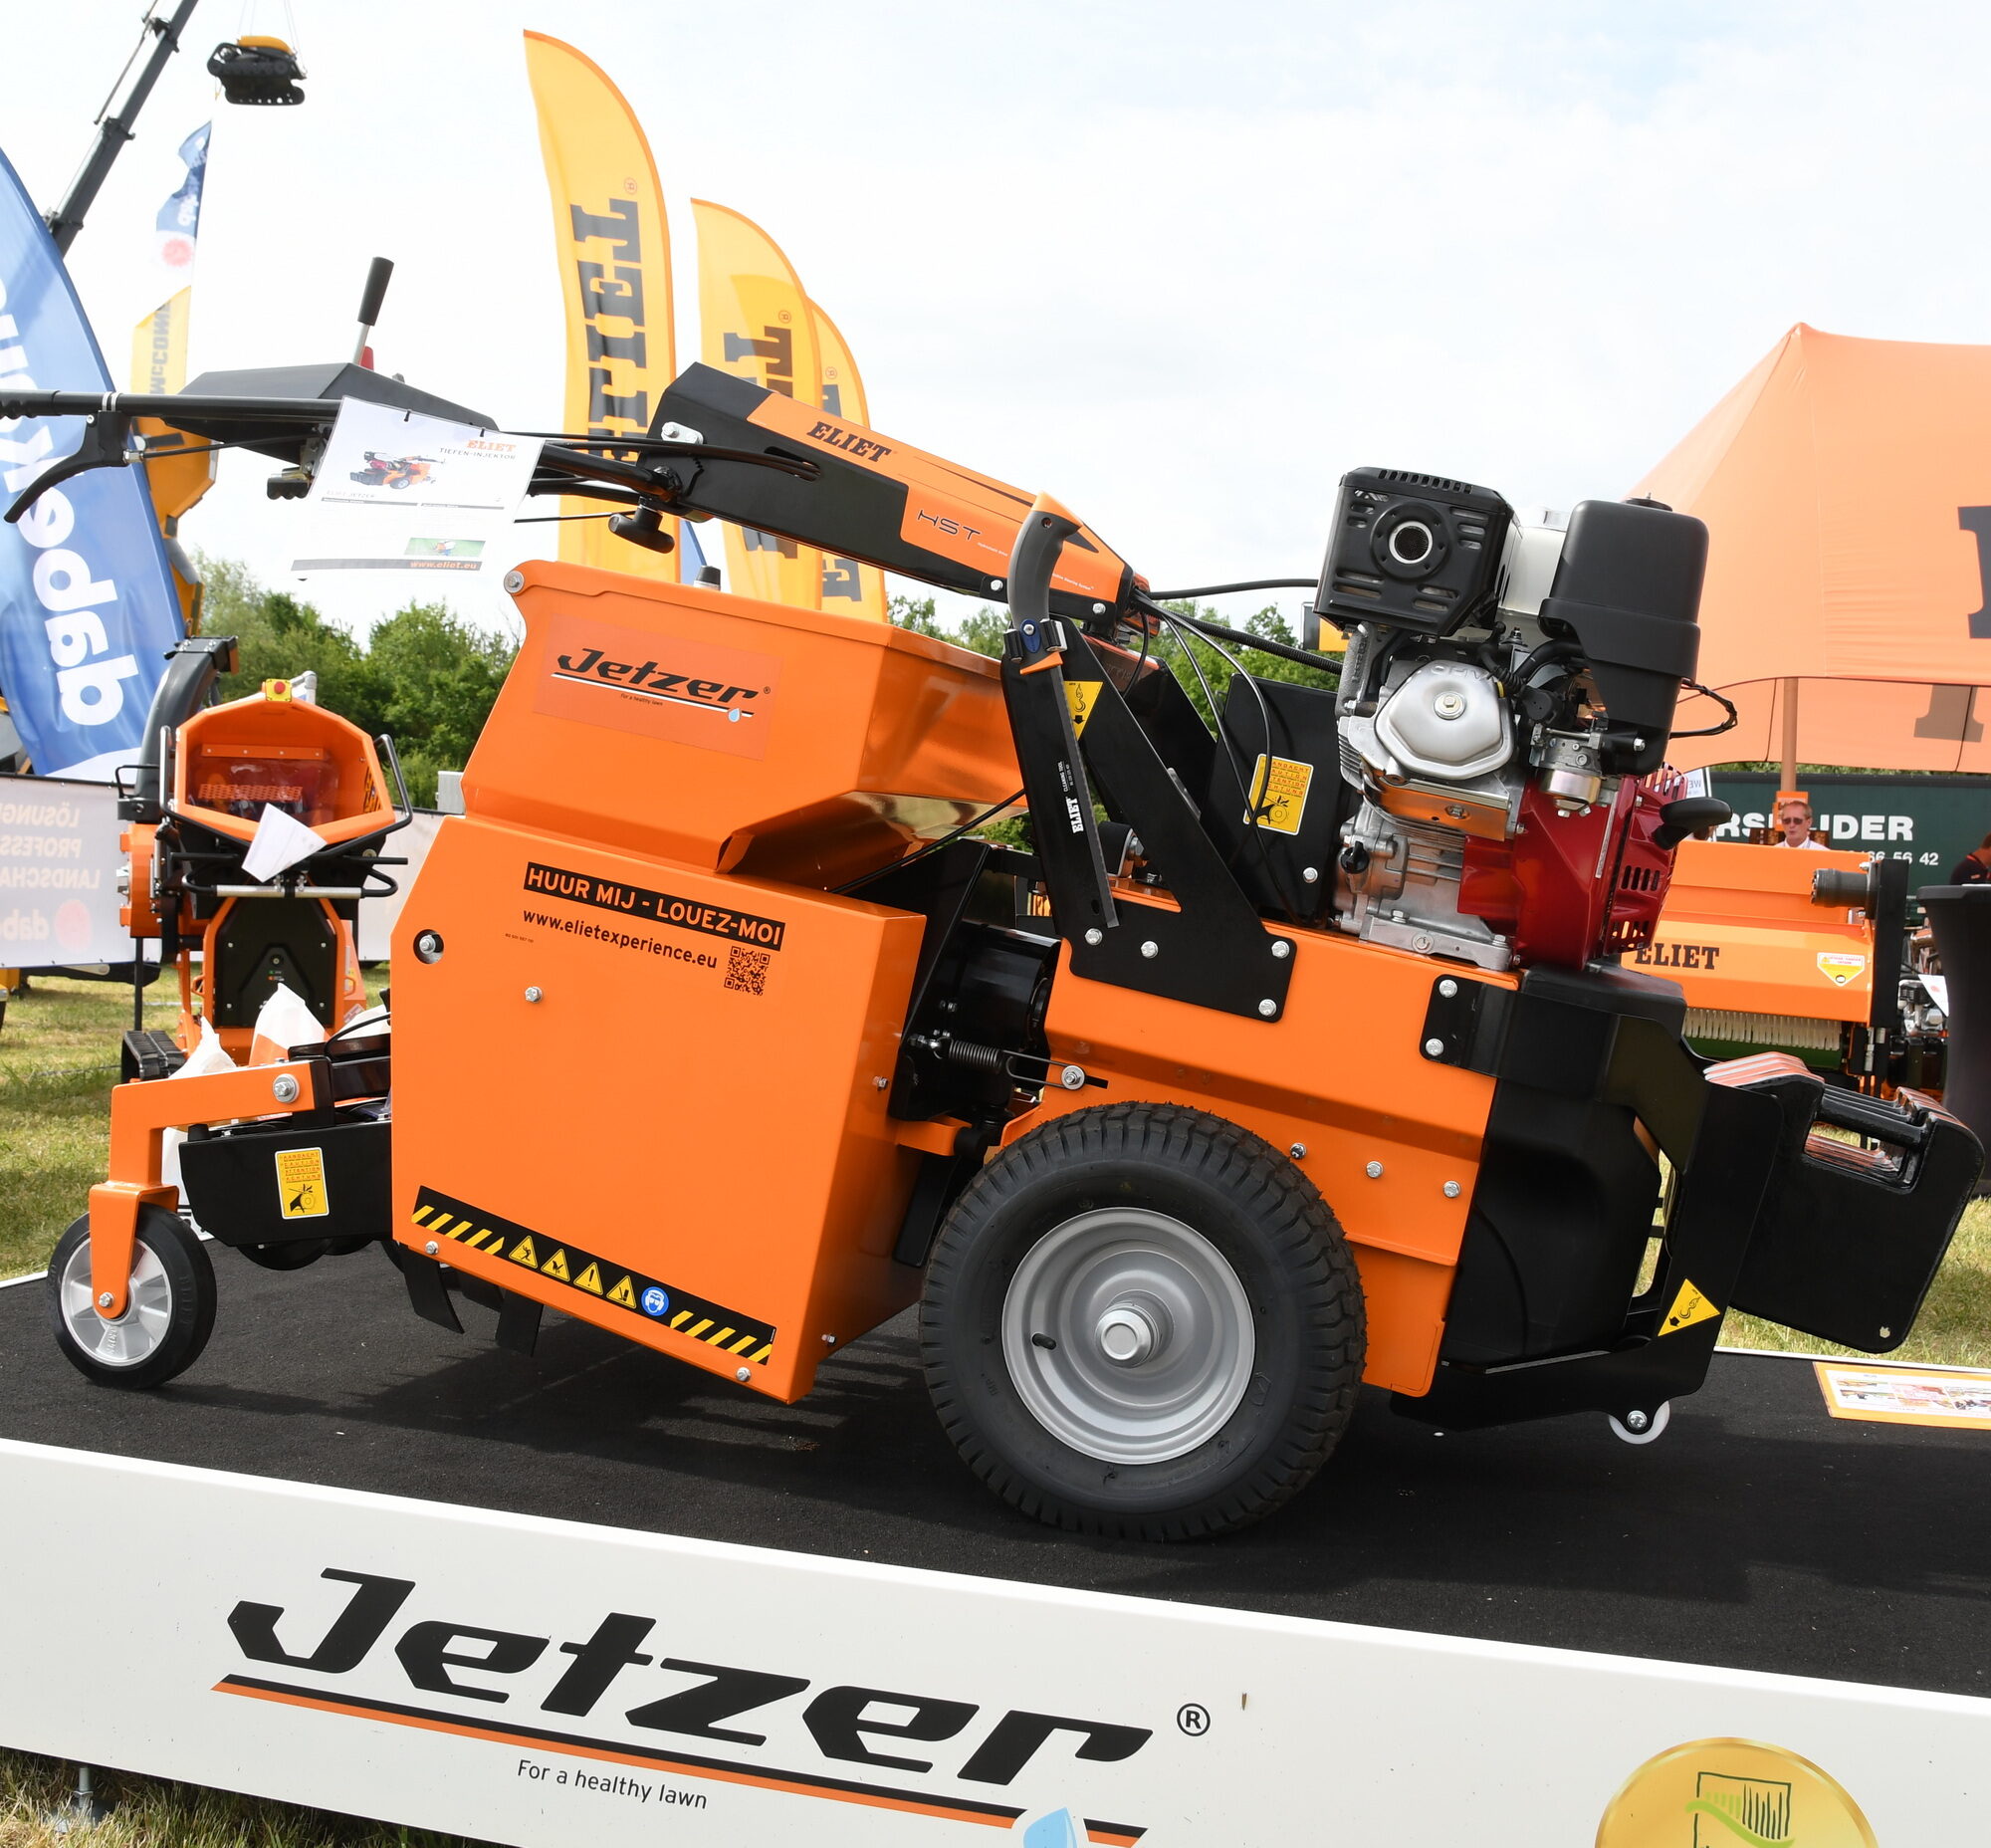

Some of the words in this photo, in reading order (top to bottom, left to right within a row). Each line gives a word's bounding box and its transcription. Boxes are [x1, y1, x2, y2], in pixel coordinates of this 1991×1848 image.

[466, 439, 517, 452] ELIET
[806, 421, 892, 463] ELIET
[917, 509, 982, 541] HST
[409, 561, 478, 570] www.eliet.eu
[556, 647, 760, 704] Jetzer
[1271, 770, 1307, 781] AUTION
[1272, 761, 1310, 773] ANDACHT
[1065, 798, 1084, 833] ELIET
[1919, 851, 1939, 865] 42
[527, 866, 591, 900] HUUR
[595, 884, 636, 909] MIJ
[656, 896, 781, 945] LOUEZ-MOI
[523, 909, 718, 969] www.elietexperience.eu
[1634, 943, 1720, 970] ELIET
[227, 1567, 1154, 1787] Jetzer
[517, 1758, 551, 1781] For
[555, 1769, 568, 1784] a
[574, 1769, 653, 1803] healthy
[658, 1783, 708, 1810] lawn
